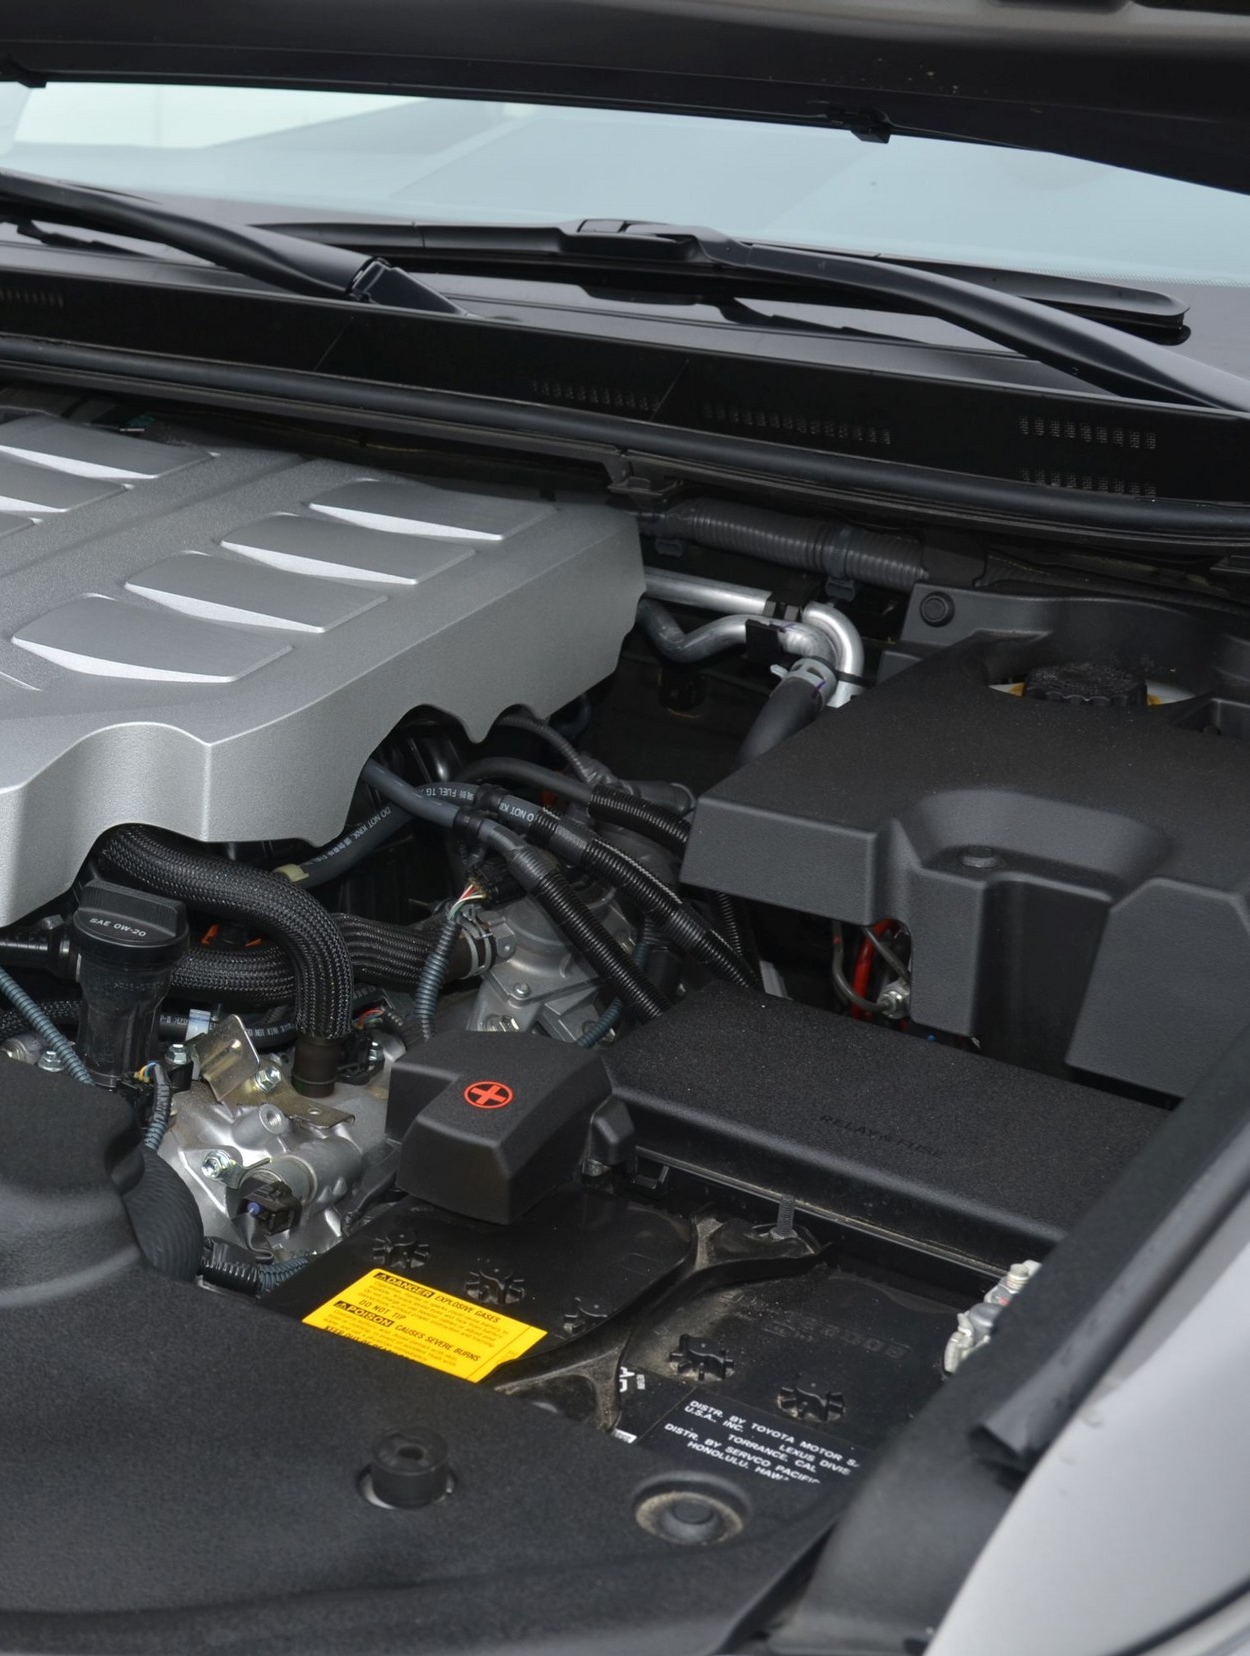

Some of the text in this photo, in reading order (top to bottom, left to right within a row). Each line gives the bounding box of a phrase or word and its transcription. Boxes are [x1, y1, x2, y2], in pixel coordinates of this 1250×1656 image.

[438, 787, 457, 798] FUEL
[367, 813, 382, 828] NOT
[510, 806, 527, 819] NOT
[89, 917, 111, 927] SAE
[358, 1299, 407, 1320] DO NOT TIP
[386, 1276, 501, 1323] DANGER EXPLOSIVE GASES
[347, 1305, 481, 1362] POISON CAUSES SEVERE BURNS
[664, 1423, 699, 1441] DISTR.
[704, 1438, 722, 1448] BY
[724, 1446, 771, 1467] SERVCO
[689, 1400, 724, 1418] DISTR.
[729, 1415, 747, 1424] BY
[751, 1422, 795, 1444] TOYOTA
[799, 1440, 843, 1461] MOTOR
[722, 1420, 744, 1433] INC.
[778, 1444, 816, 1462] LEXUS
